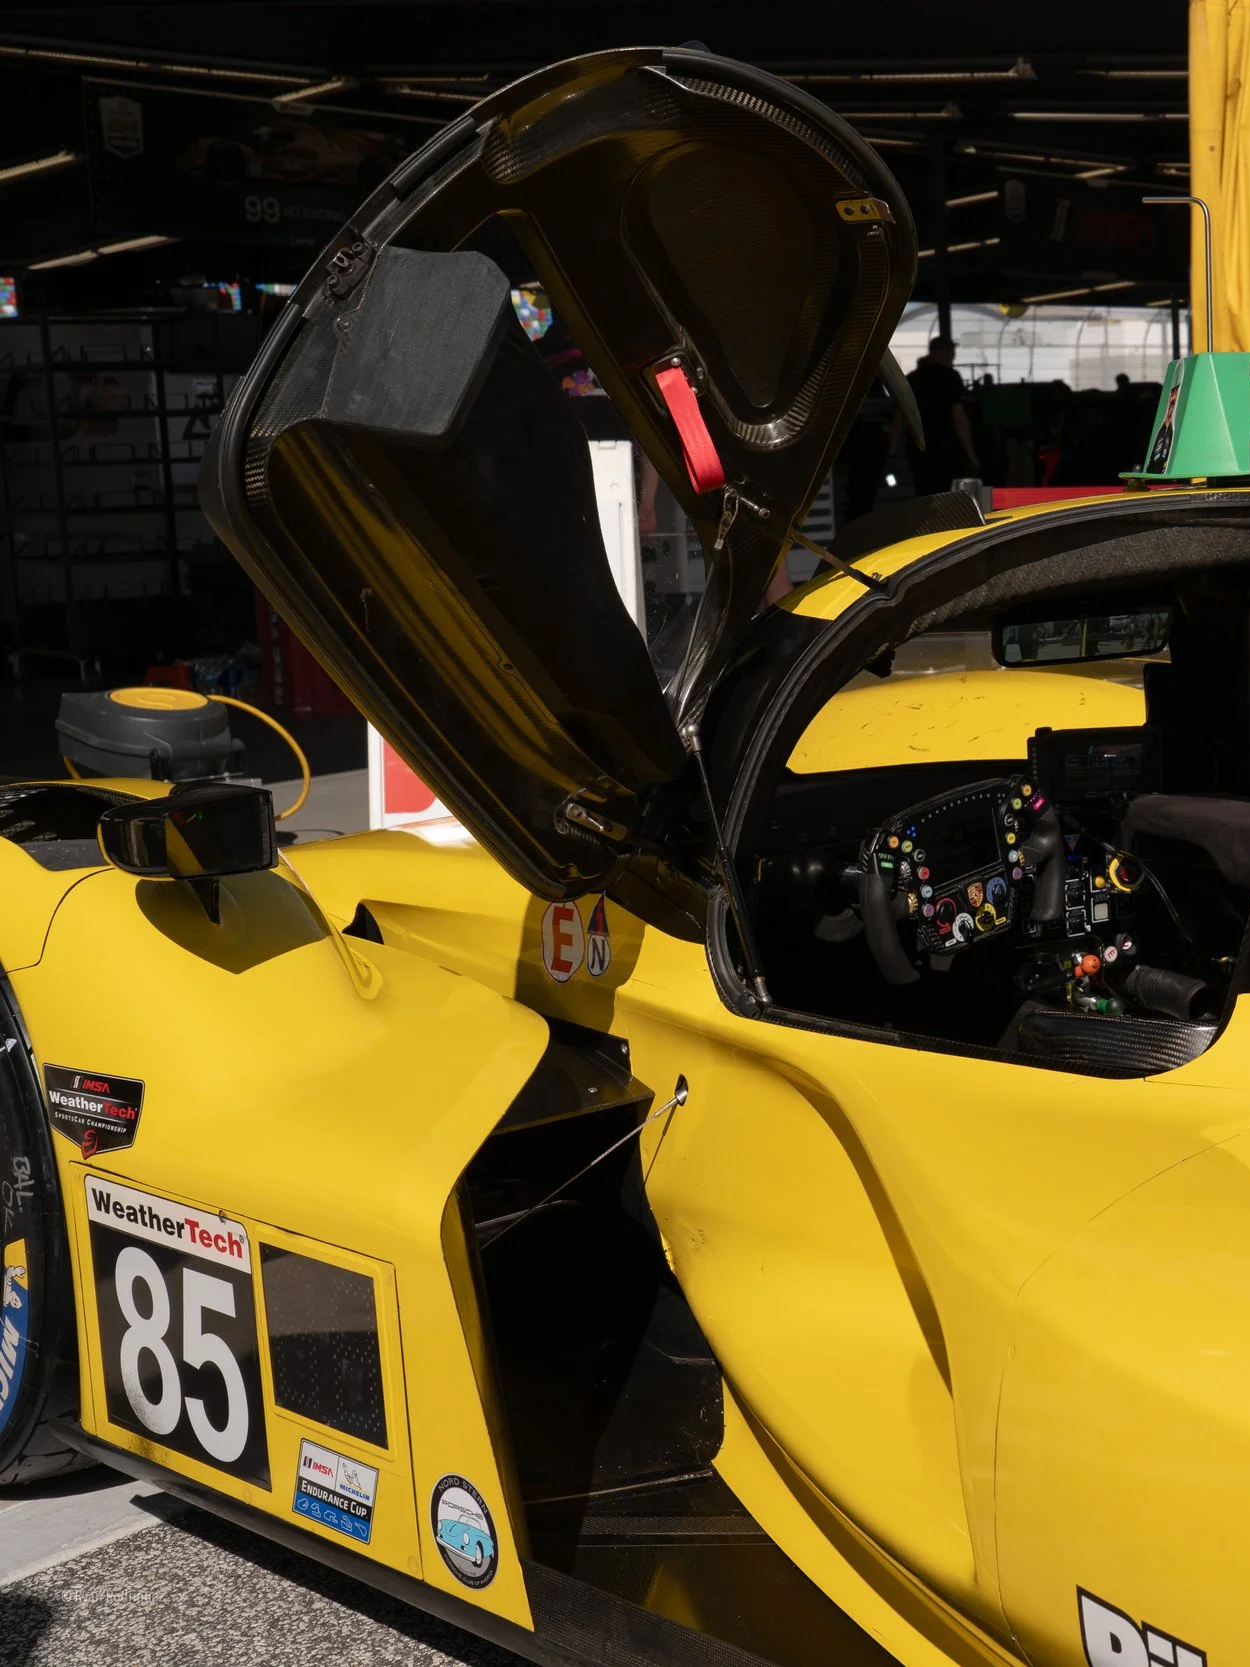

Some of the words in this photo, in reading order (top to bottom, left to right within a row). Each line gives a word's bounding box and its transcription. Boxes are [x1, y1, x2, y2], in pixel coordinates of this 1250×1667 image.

[244, 195, 281, 224] 99
[551, 906, 574, 973] E
[591, 937, 606, 971] N
[82, 1079, 111, 1094] IMSA
[86, 1119, 128, 1134] CHAMPIONSHIP
[114, 1246, 250, 1463] 85
[312, 1461, 334, 1478] IMSA
[301, 1480, 349, 1510] ENDURANCE
[339, 1484, 371, 1501] MICHELIN
[437, 1477, 460, 1493] NORD
[462, 1480, 488, 1514] STERN
[441, 1499, 483, 1520] PORSCHE
